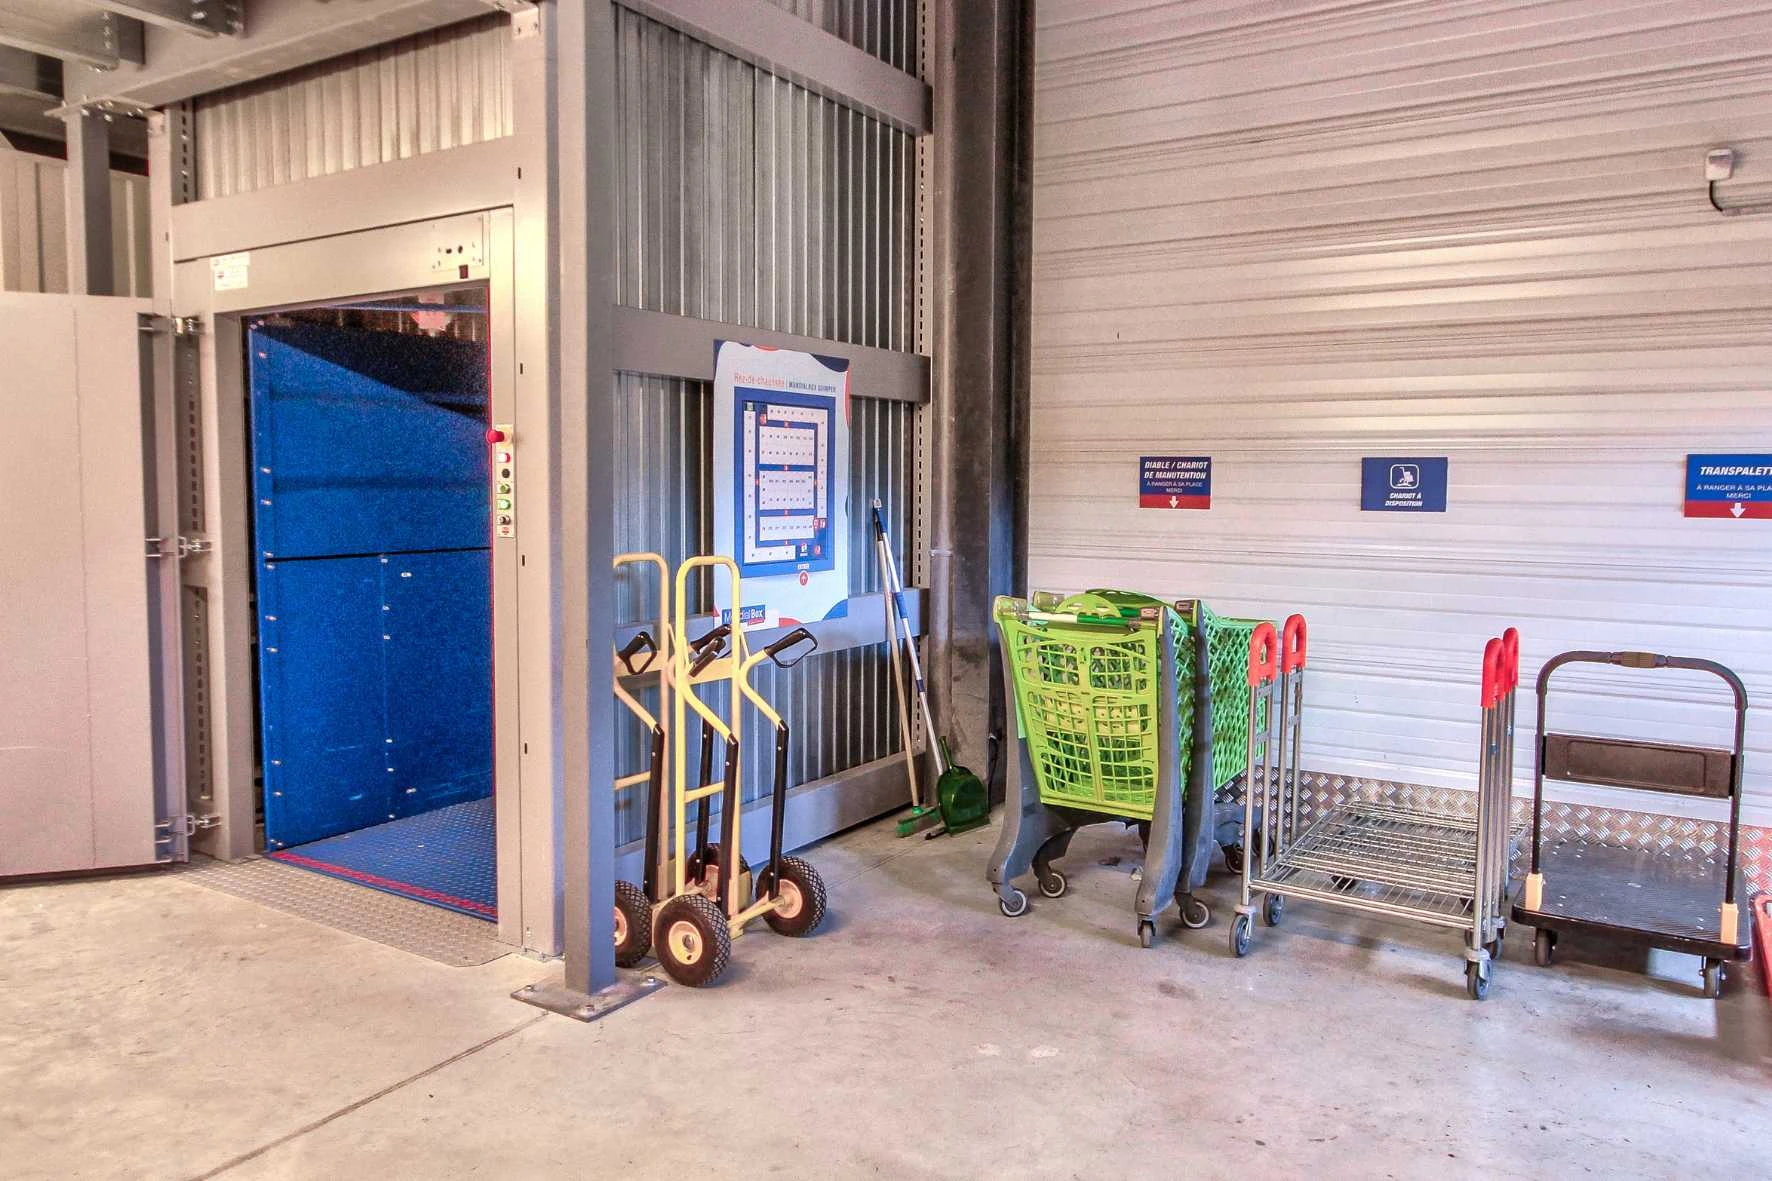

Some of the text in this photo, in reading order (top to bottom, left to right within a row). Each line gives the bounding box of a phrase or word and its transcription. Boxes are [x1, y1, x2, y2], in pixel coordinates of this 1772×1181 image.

[1144, 461, 1208, 469] DIABLE / CHARIOT
[1144, 471, 1207, 479] DE MANUTENTION
